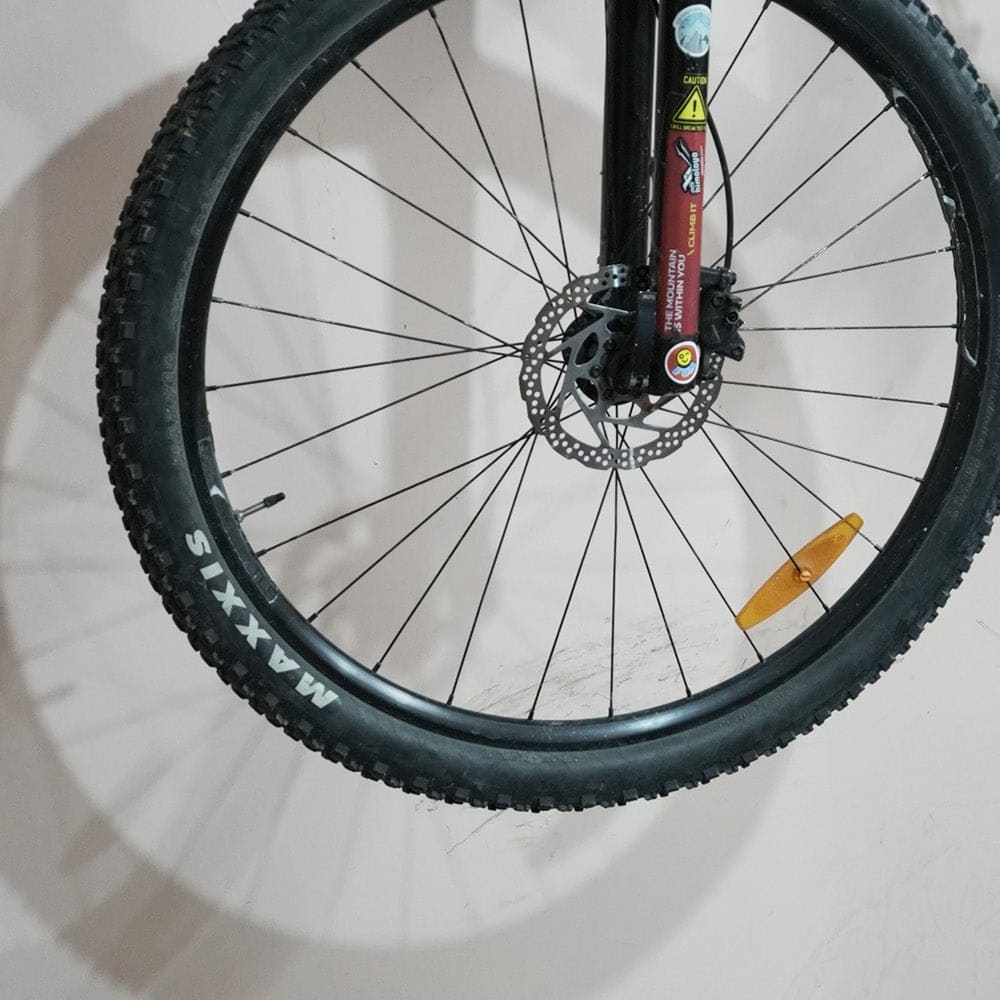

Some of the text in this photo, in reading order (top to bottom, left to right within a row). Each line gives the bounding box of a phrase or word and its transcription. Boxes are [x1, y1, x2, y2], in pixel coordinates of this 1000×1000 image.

[683, 75, 708, 85] CAUTIO
[692, 152, 701, 193] himalaya
[688, 214, 696, 248] CLIMB
[677, 254, 686, 278] YOU
[664, 249, 677, 332] THE MOUNTAIN
[675, 280, 684, 321] WITHIN
[184, 528, 339, 709] MAXXIS
